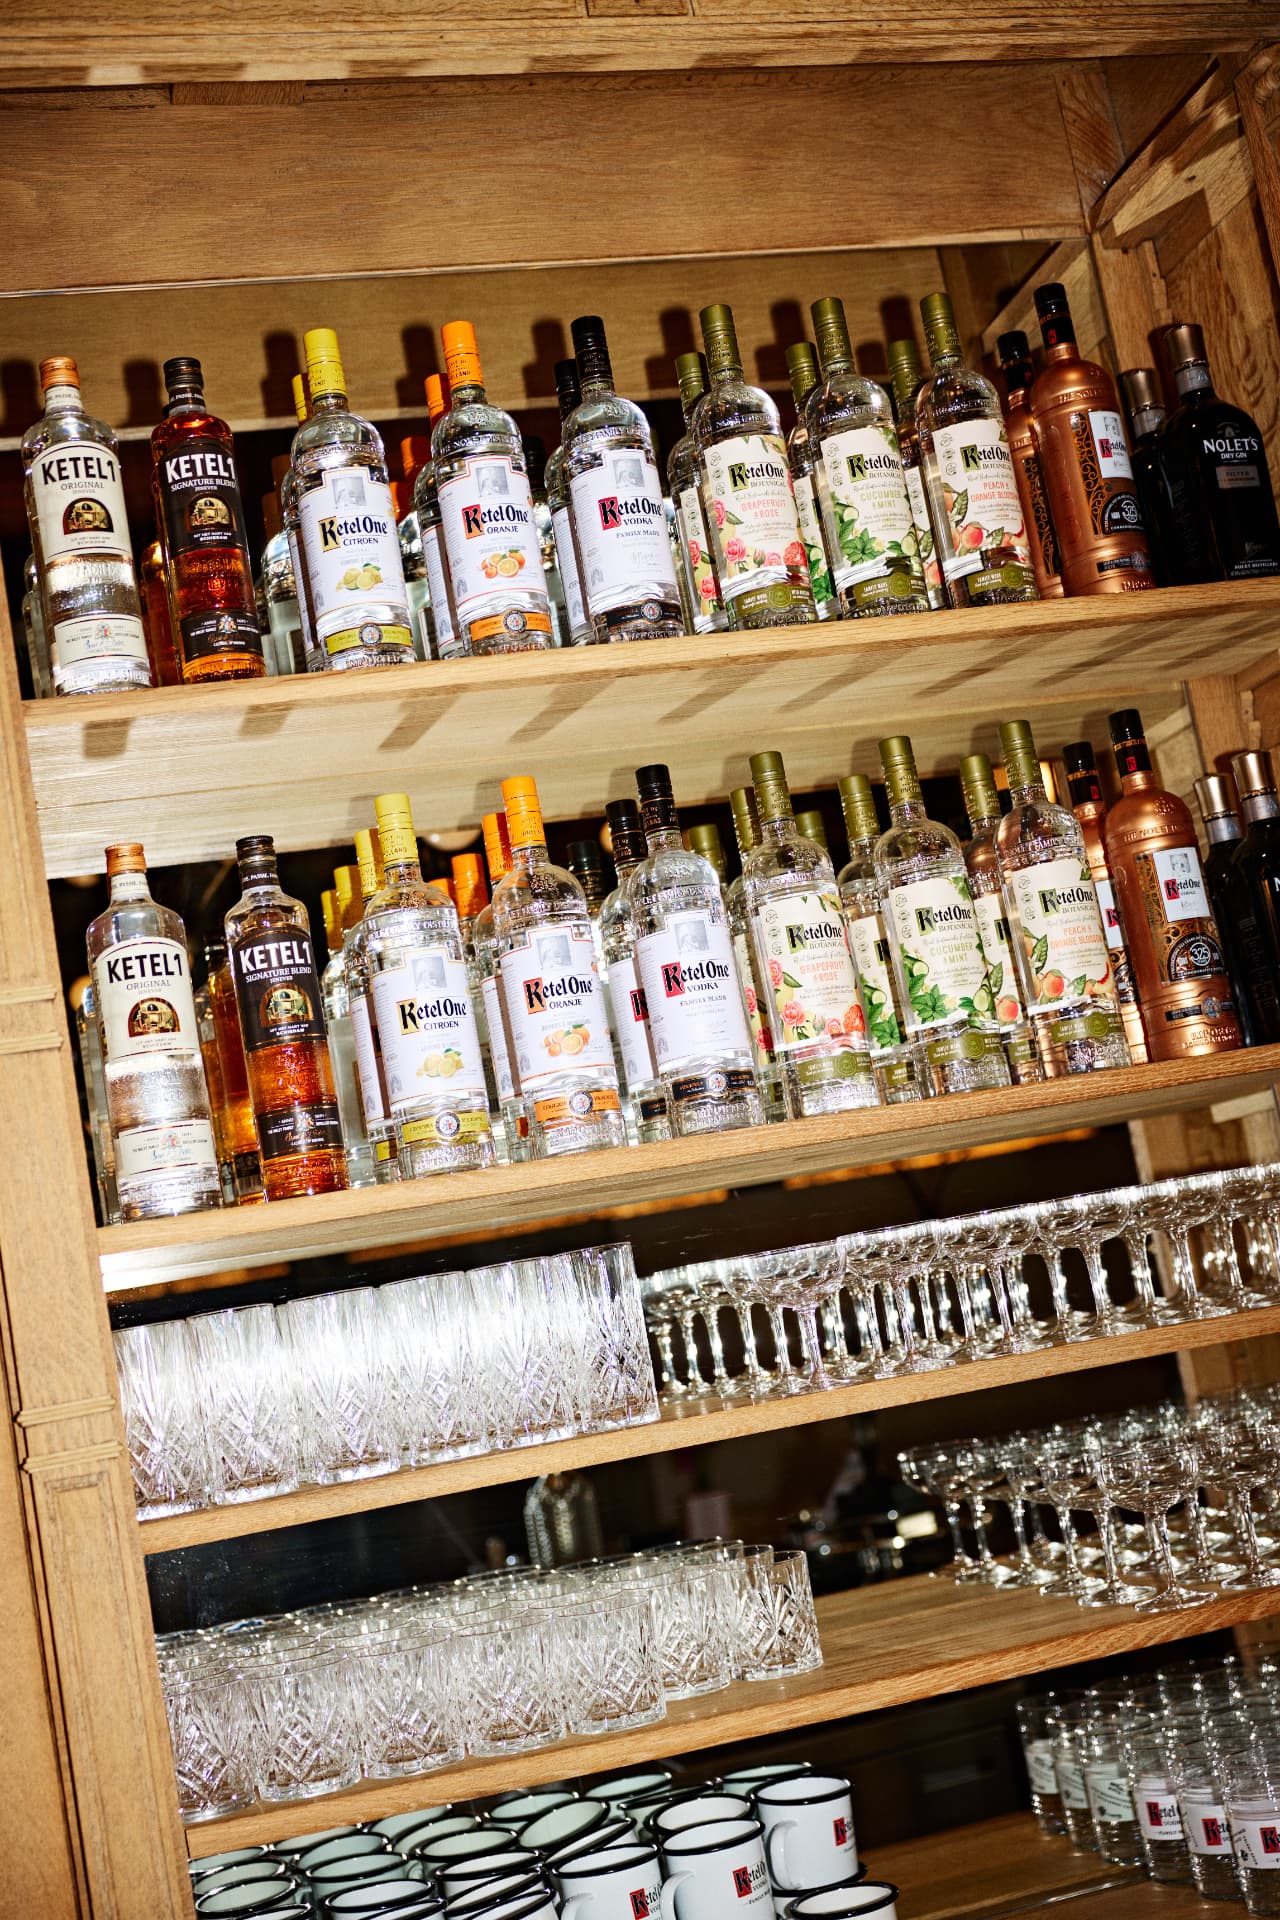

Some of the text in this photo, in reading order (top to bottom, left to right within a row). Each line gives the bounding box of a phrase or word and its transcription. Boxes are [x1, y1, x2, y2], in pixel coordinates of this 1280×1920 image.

[1203, 436, 1258, 454] NOLET'S
[849, 455, 882, 477] Ketel
[963, 447, 995, 468] Ketel
[730, 463, 784, 488] Ketel One
[61, 482, 105, 491] ORIGINAL
[171, 478, 214, 492] SIGNATURE
[599, 498, 662, 525] Ketel One
[741, 499, 787, 513] GRAPEFRUIT
[463, 504, 528, 534] Ketel One
[623, 517, 653, 526] VODKA
[320, 516, 388, 546] Ketel One
[487, 525, 519, 534] ORANJE
[343, 537, 379, 546] CITROEN
[1166, 879, 1189, 897] Ketel
[1042, 887, 1093, 913] Ketel One
[918, 905, 972, 931] Ketel One
[788, 922, 842, 948] Ketel One
[929, 942, 973, 956] CUCUMBER
[1191, 947, 1209, 961] 325
[245, 966, 312, 983] SIGNATURE BLEND
[664, 960, 729, 992] Ketel One
[800, 961, 844, 974] GRAPEFRUIT
[126, 979, 171, 991] ORIGINAL
[526, 976, 593, 1009] Ketel One
[687, 982, 719, 993] VODKA
[549, 999, 583, 1009] ORANJE
[400, 998, 467, 1030] Ketel One
[424, 1020, 460, 1030] CITROEN
[736, 1864, 761, 1892] Ketel
[632, 1887, 659, 1915] Ketel
